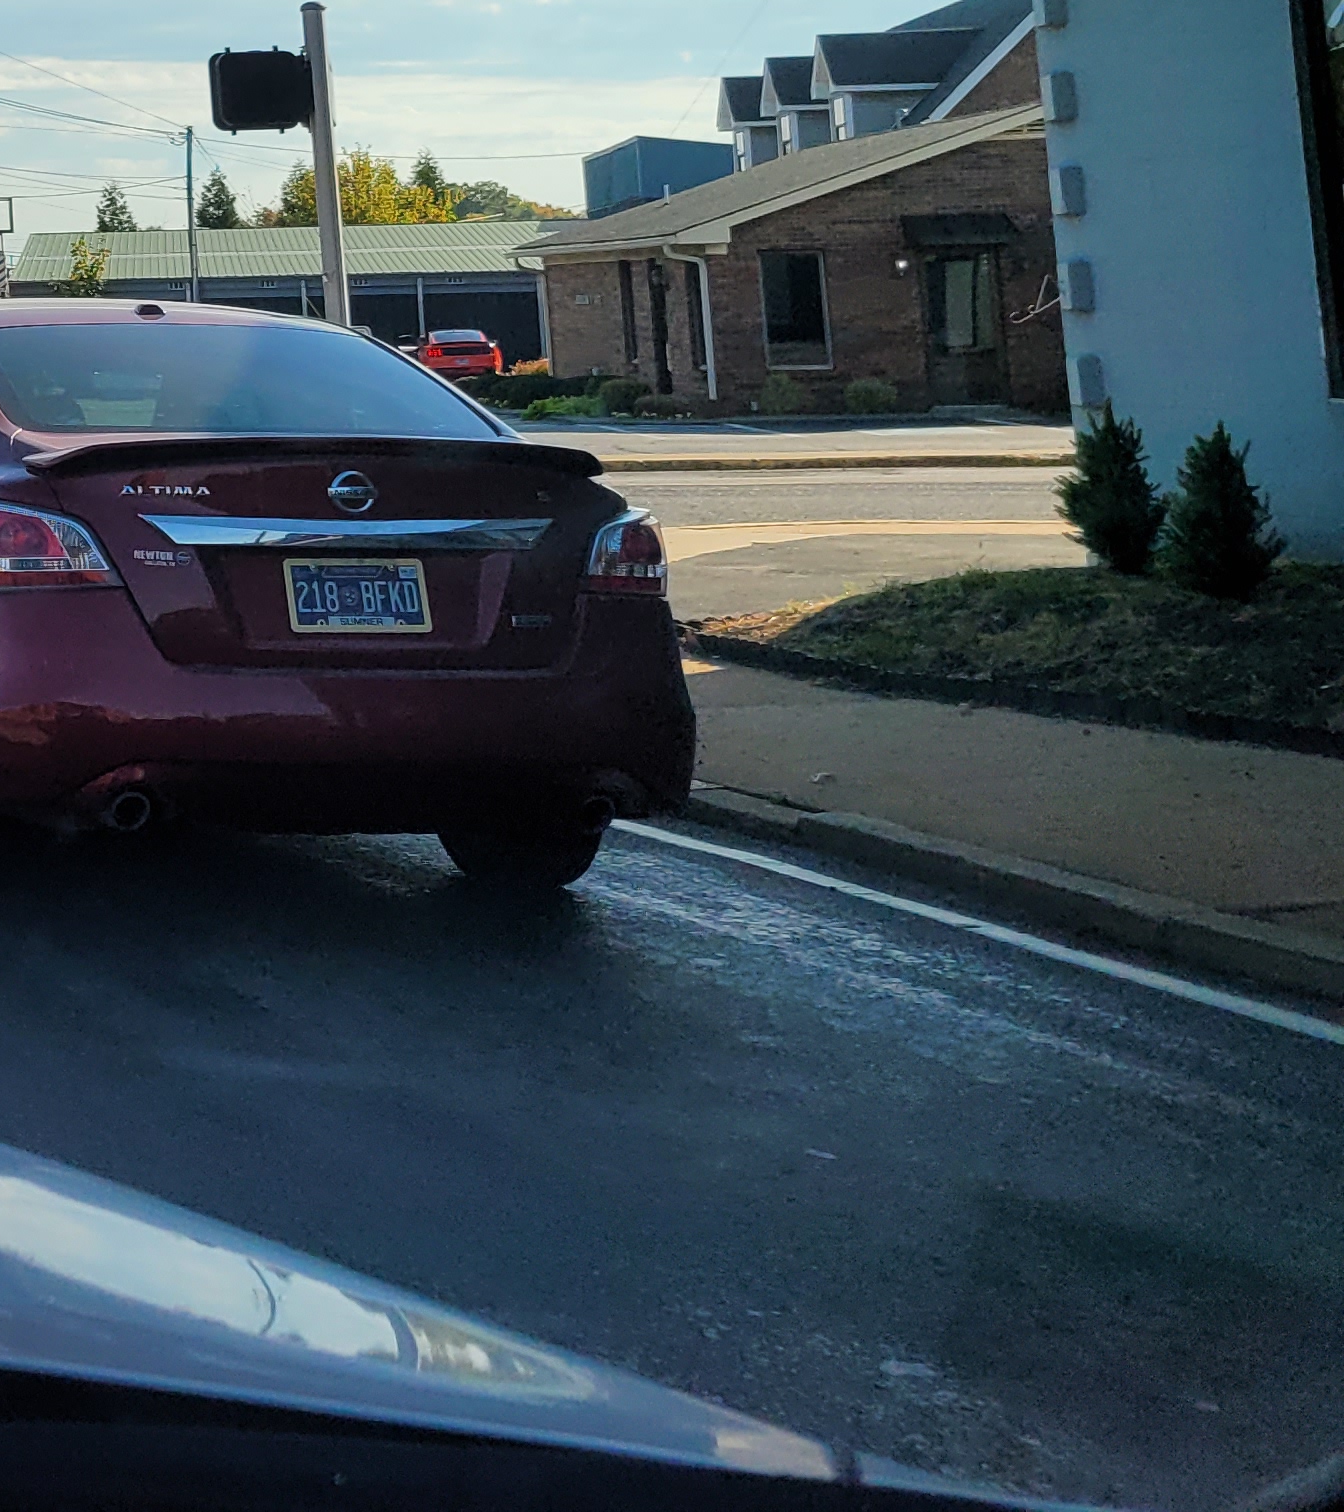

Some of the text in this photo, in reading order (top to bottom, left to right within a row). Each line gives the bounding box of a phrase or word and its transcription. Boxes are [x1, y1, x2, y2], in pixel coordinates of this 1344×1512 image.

[119, 485, 211, 497] ALTIMA
[296, 581, 420, 613] 218 BFKD
[339, 617, 384, 626] SUMNER
